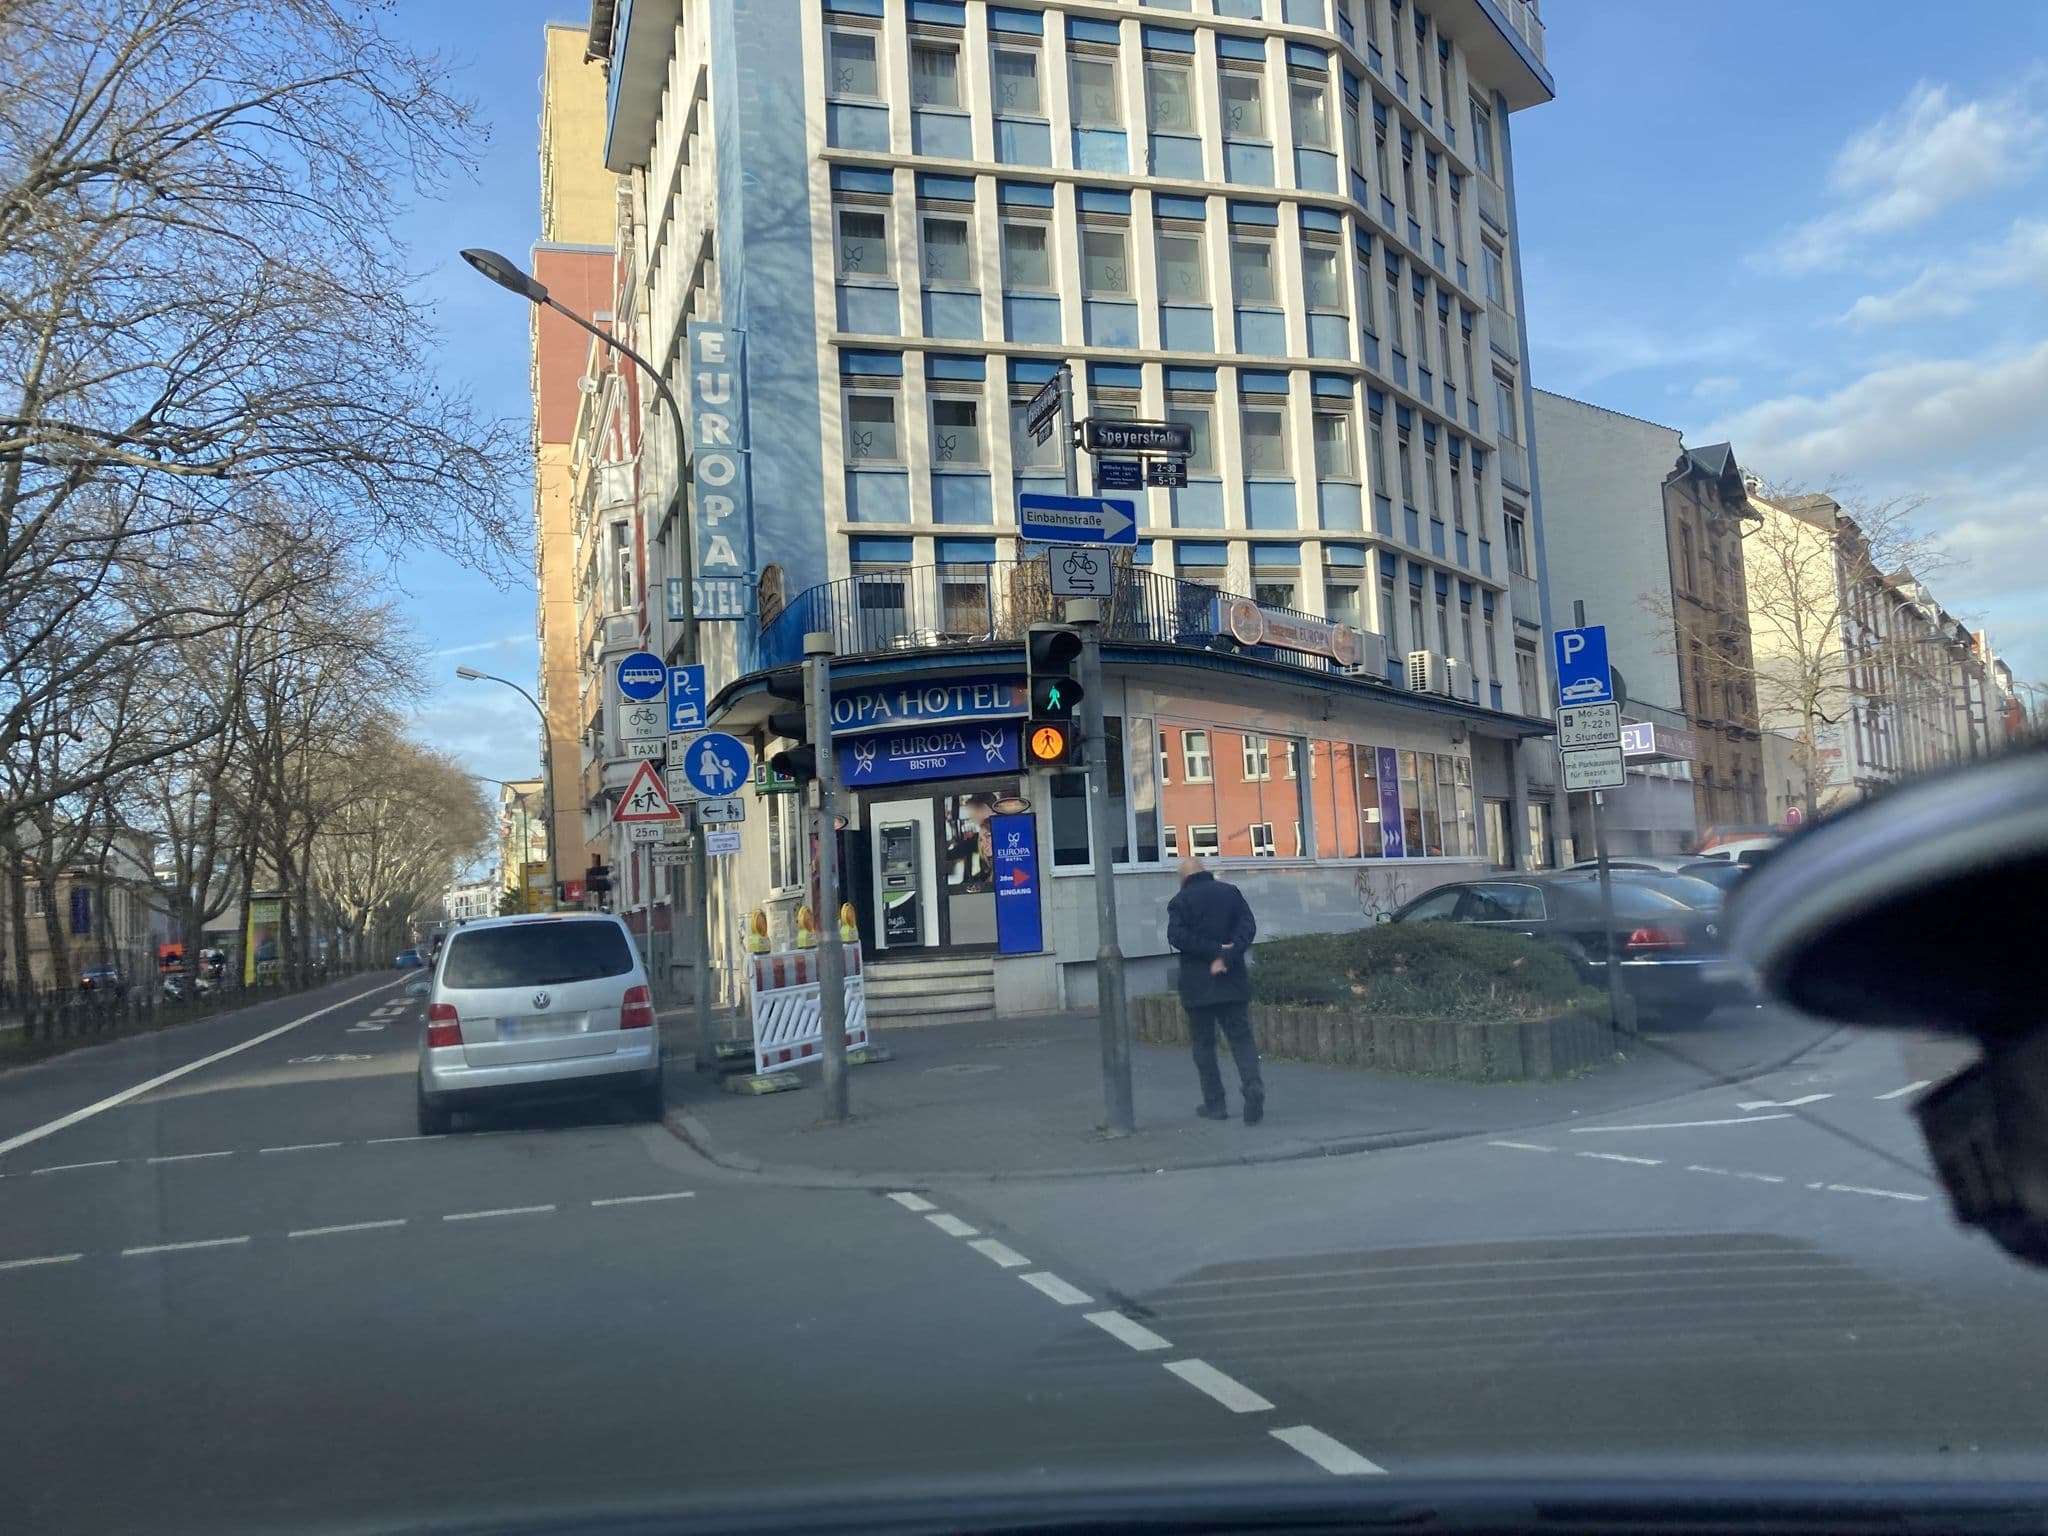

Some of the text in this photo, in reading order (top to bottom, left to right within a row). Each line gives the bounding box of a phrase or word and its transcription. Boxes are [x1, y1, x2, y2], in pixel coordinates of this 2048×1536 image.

[697, 331, 739, 567] EUROPA
[1026, 511, 1102, 527] Einbahnstraße
[671, 581, 742, 615] HOTEL
[1563, 634, 1585, 664] P
[673, 670, 690, 696] P
[831, 683, 1011, 725] OPA HOTEL
[636, 727, 653, 735] frei
[1565, 732, 1615, 744] 2 Stunden
[632, 745, 658, 756] TAXI
[890, 732, 967, 756] EUROPA
[910, 757, 947, 770] BISTRO
[997, 847, 1031, 857] EUROPA
[1000, 887, 1032, 896] EINGANG
